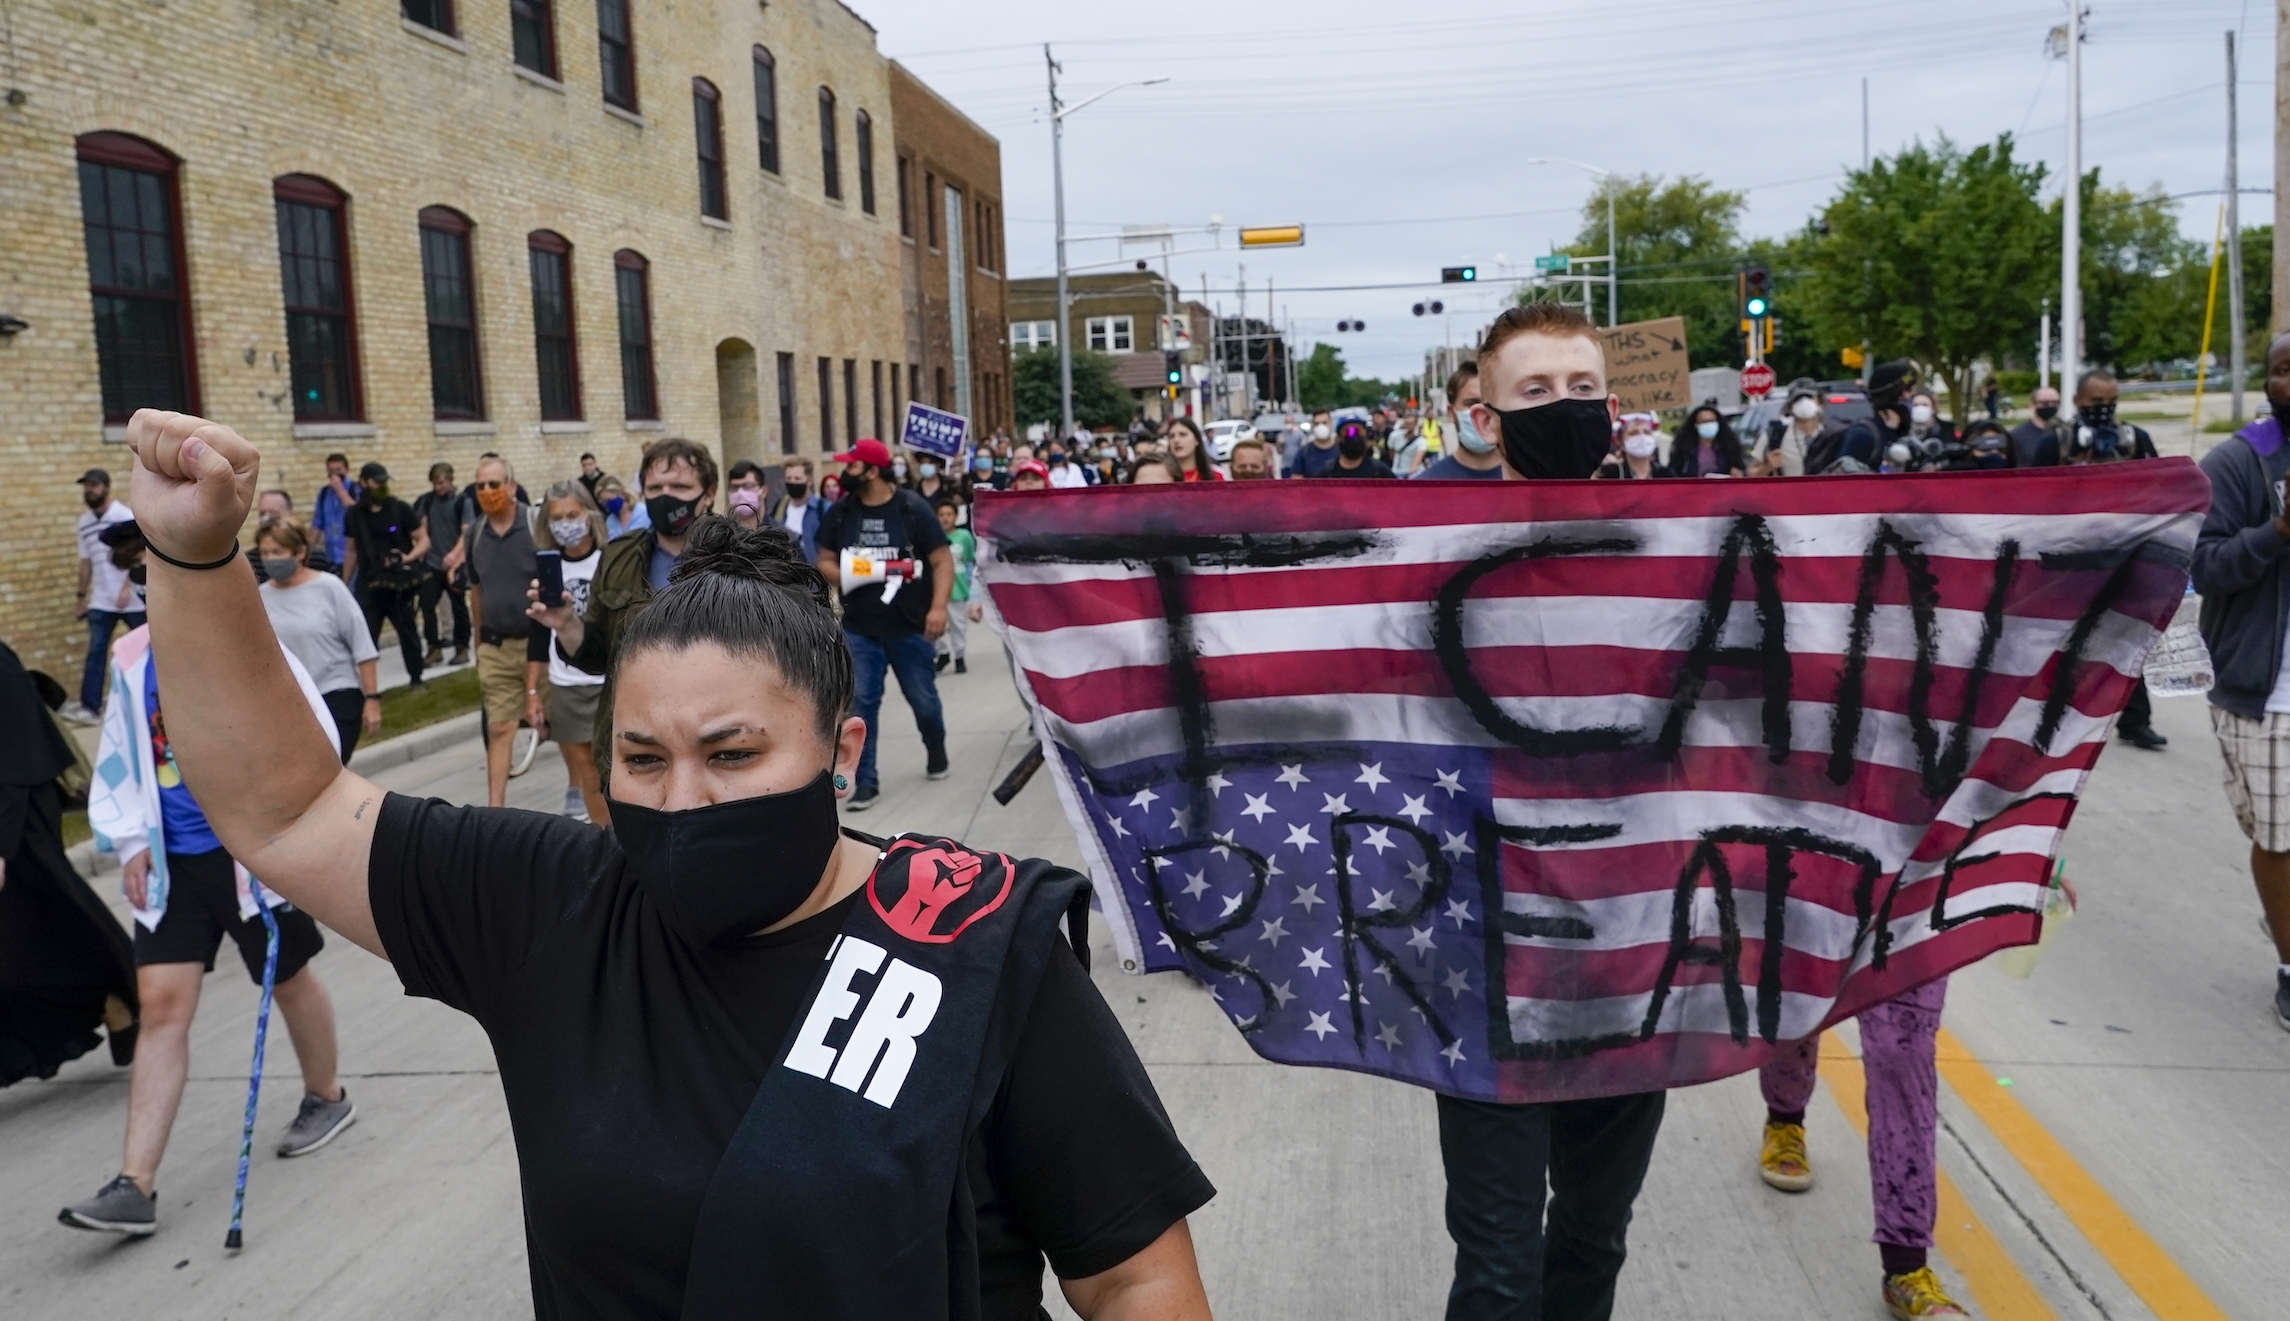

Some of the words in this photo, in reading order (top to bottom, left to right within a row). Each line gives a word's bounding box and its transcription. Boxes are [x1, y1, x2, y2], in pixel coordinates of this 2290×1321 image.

[1741, 373, 1773, 388] STOP
[909, 413, 962, 437] TRUMP
[783, 933, 943, 1109] ER
